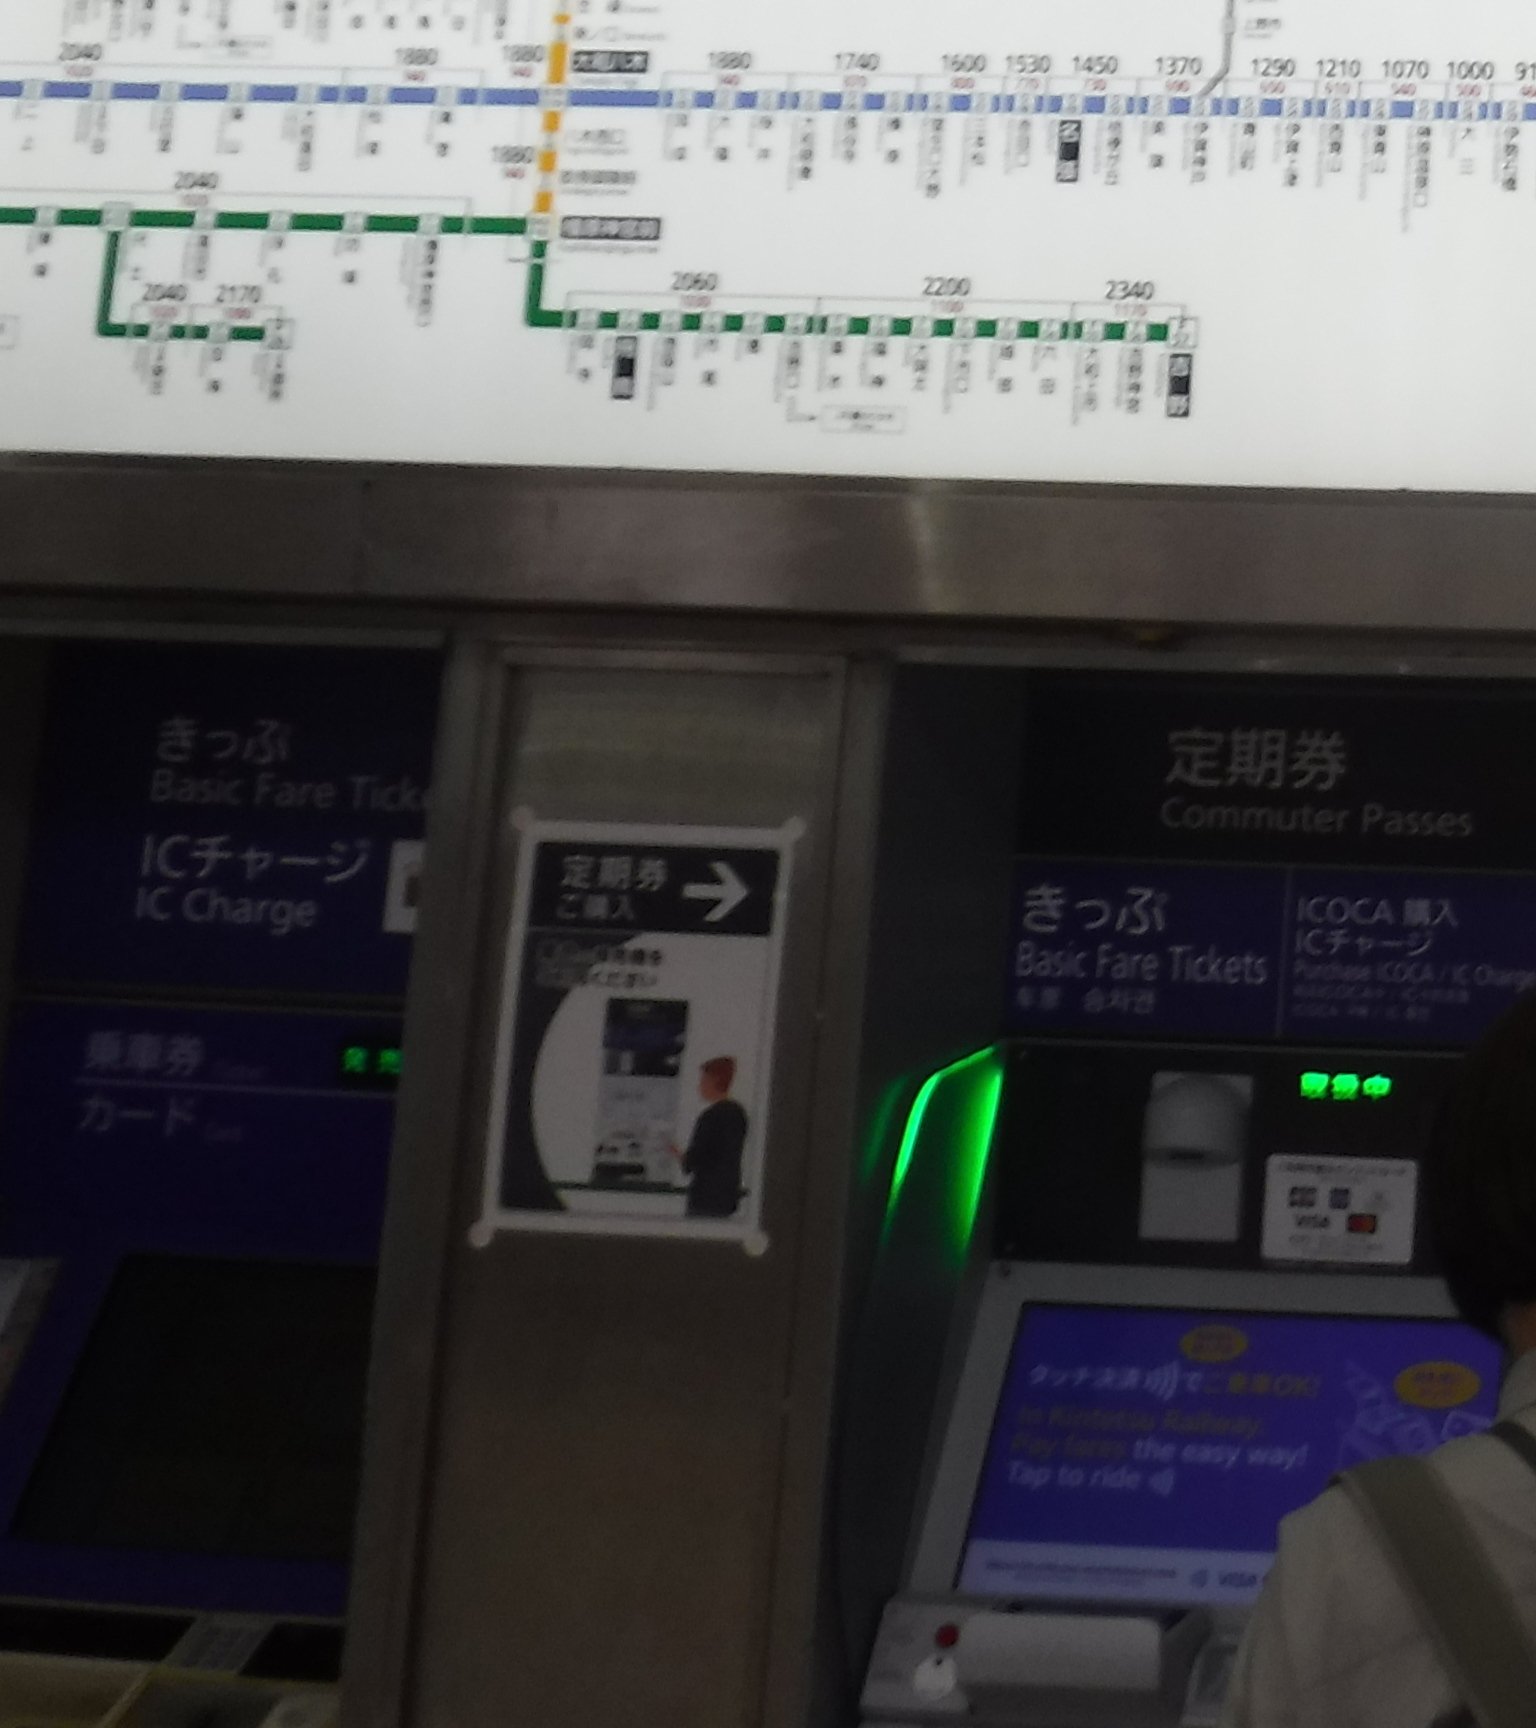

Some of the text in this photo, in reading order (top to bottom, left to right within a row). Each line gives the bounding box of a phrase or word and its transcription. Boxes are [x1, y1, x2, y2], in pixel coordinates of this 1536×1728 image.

[156, 717, 291, 764] きっぷ
[1166, 728, 1348, 791] 定期券
[150, 769, 426, 811] Basic Fare Tick
[1161, 798, 1474, 838] Commuter Passes
[141, 834, 371, 884] ICチャージ
[562, 855, 667, 891] 定期券
[136, 887, 319, 937] IC Charge
[1023, 884, 1169, 934] きっぷ
[1299, 897, 1392, 925] ICOCA
[1016, 943, 1267, 985] Basic Fare Tickets
[1134, 1438, 1175, 1462] the
[1182, 1442, 1240, 1470] easy
